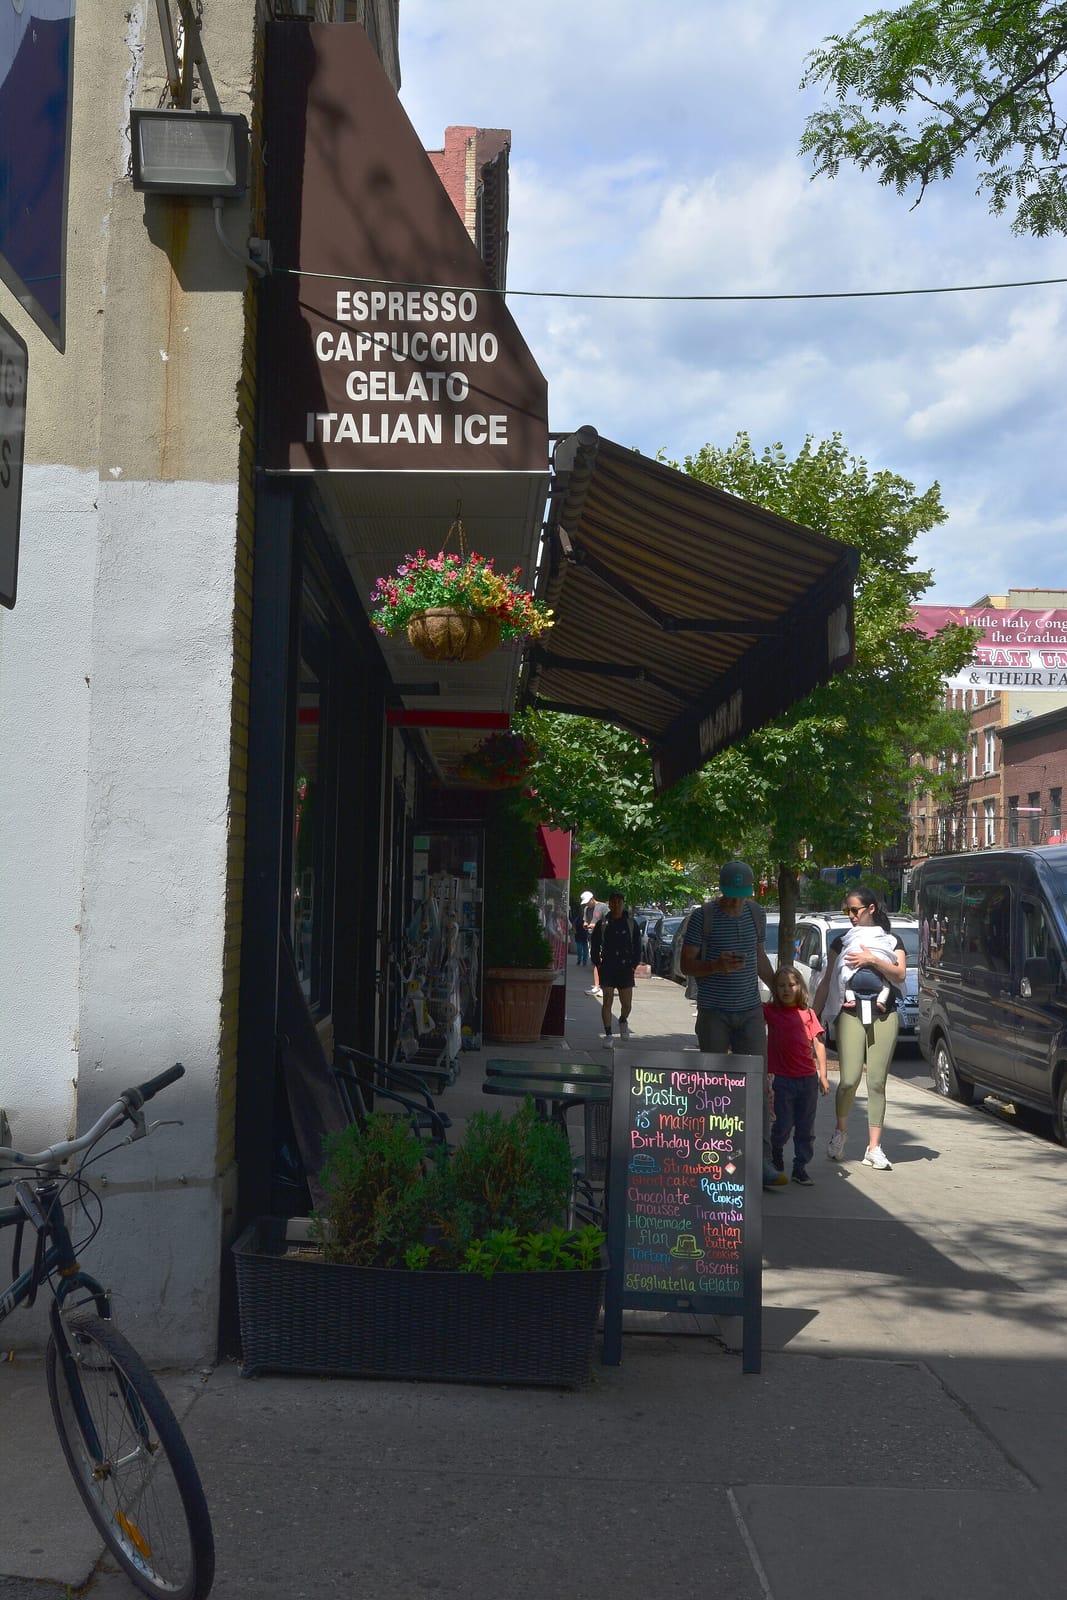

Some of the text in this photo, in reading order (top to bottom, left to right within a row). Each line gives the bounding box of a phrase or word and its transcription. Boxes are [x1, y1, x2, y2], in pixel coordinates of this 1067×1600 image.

[335, 290, 478, 322] ESPRESSO
[315, 331, 499, 362] CAPPUCCINO
[345, 370, 469, 402] GELATO
[306, 412, 508, 445] ITALIAN ICE
[1001, 616, 1032, 632] Italy
[991, 630, 1012, 643] the
[969, 671, 980, 684] &
[986, 672, 1043, 686] THEIR
[630, 1130, 690, 1159] Birthday
[627, 1187, 692, 1205] Chocolate
[701, 1177, 745, 1196] Rainbow
[695, 1260, 739, 1275] Biscotti
